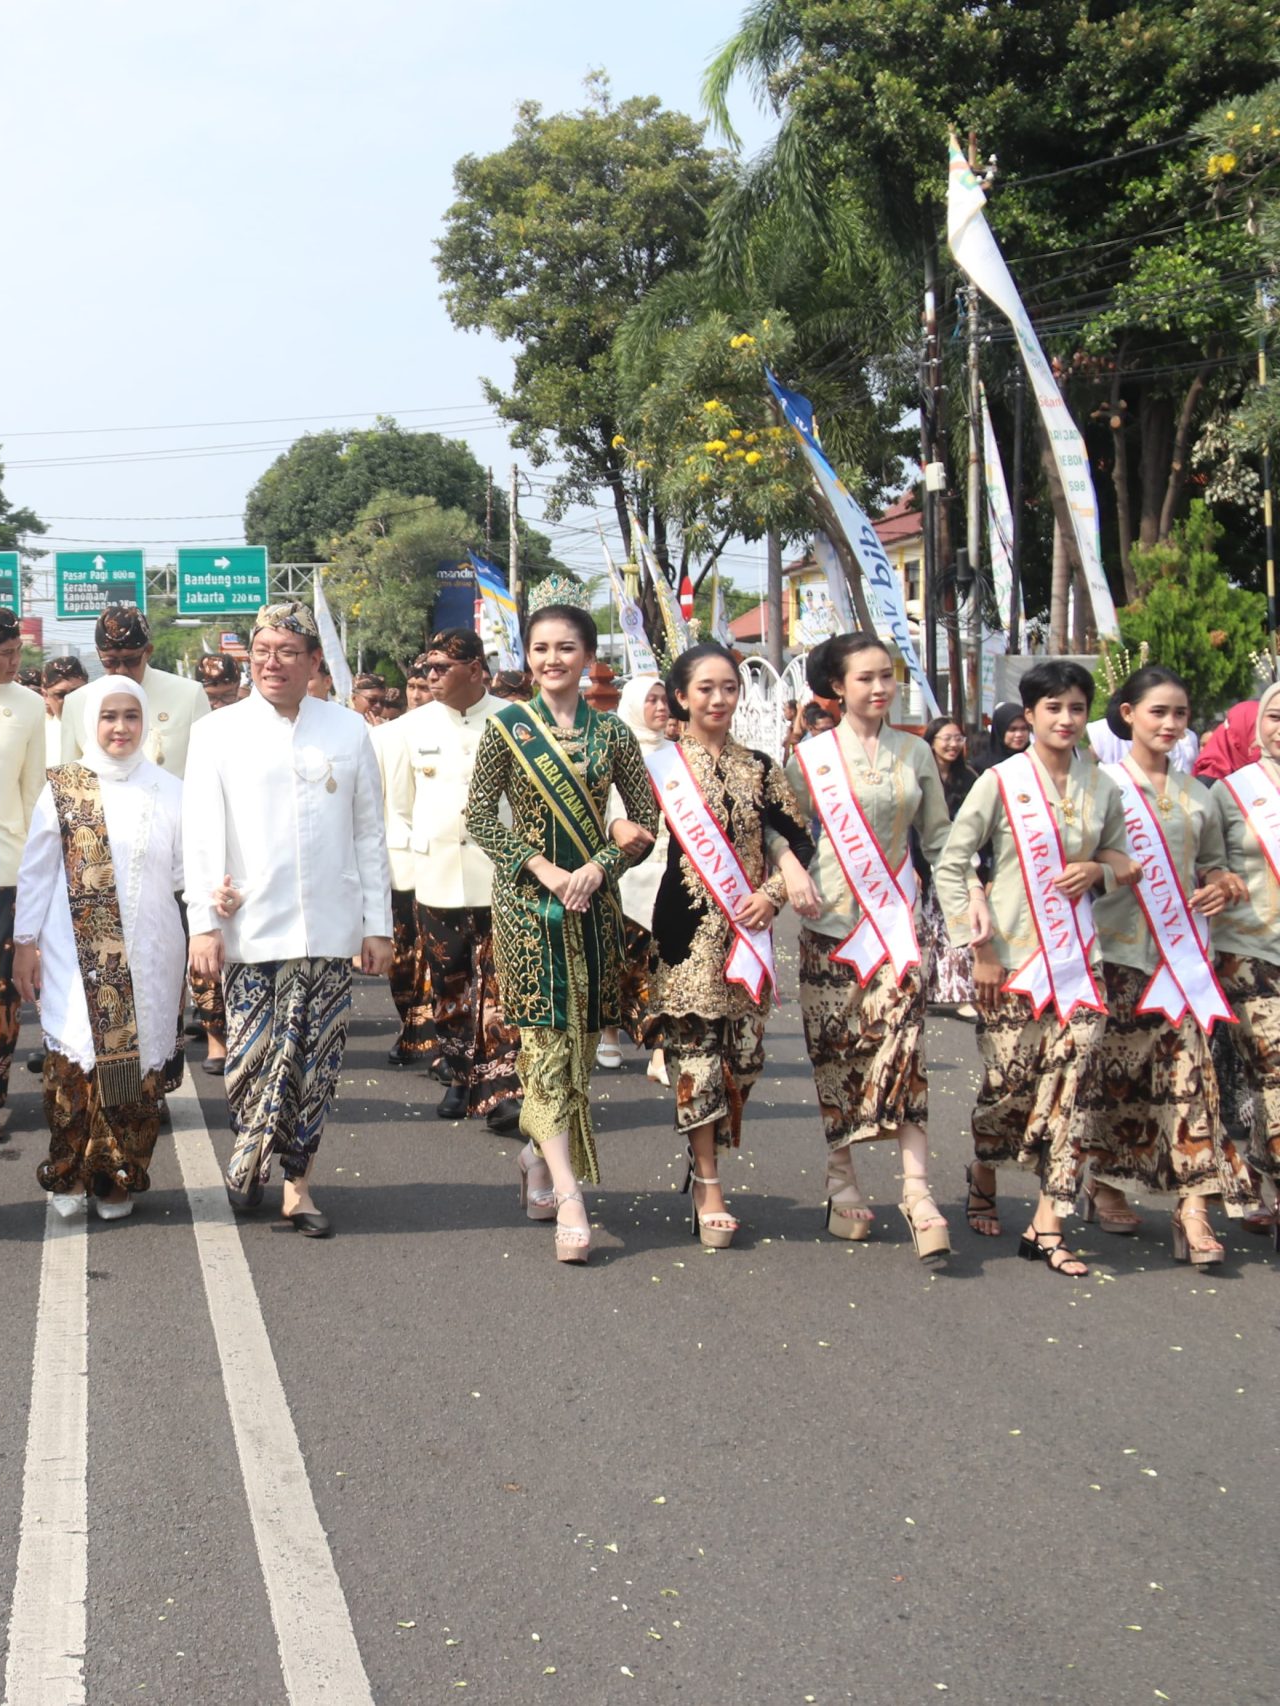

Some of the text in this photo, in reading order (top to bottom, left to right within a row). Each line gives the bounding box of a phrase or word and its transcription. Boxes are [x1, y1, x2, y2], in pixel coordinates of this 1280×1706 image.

[63, 571, 87, 581] Pasar
[90, 569, 109, 583] Pagi
[184, 573, 261, 588] Bandung 139 Km
[63, 583, 99, 592] Keraton
[63, 590, 109, 602] Kanoman/
[185, 592, 262, 604] Jakarta 220 Km
[63, 600, 118, 613] Kaprabonan
[534, 752, 601, 851] RARA UTAMA KOTA
[673, 796, 729, 875] KEBON
[821, 784, 895, 909] PANJUNAN
[1021, 812, 1071, 949] LARANGAN
